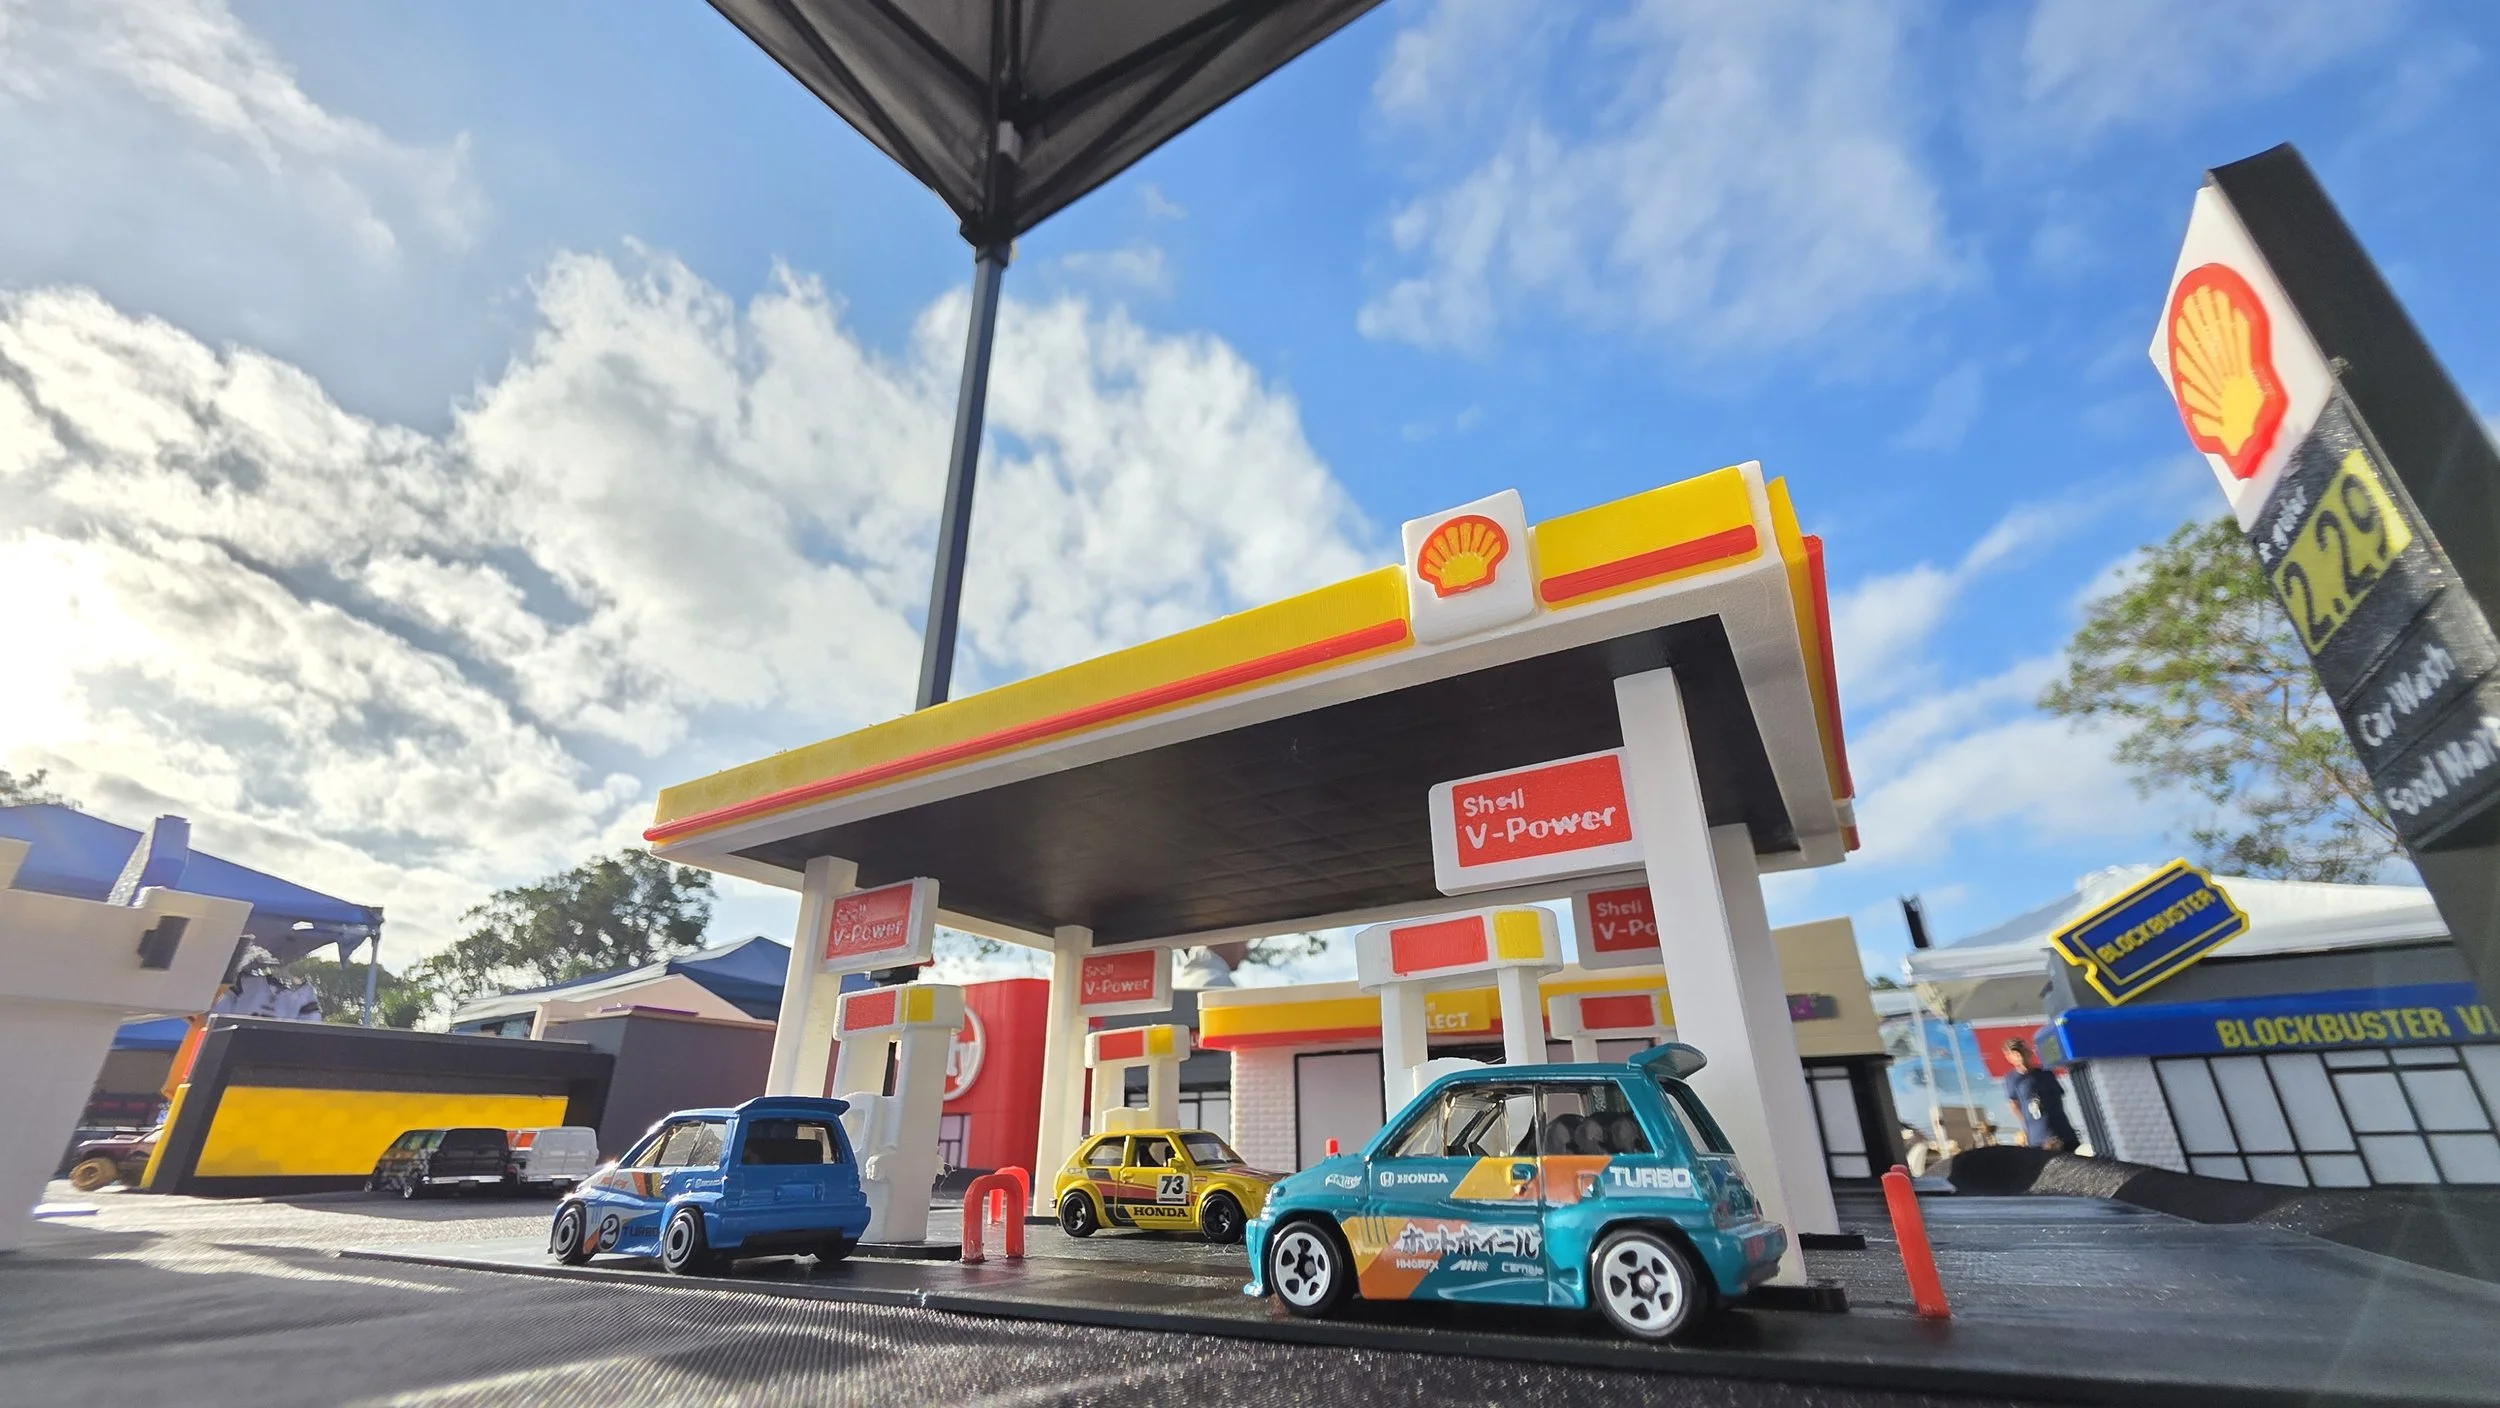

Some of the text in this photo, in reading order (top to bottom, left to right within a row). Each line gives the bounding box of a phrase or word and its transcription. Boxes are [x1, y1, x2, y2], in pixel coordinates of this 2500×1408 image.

[2283, 473, 2388, 645] 2.29
[2358, 643, 2455, 746] Car Wash
[1463, 788, 1525, 817] Shell
[1465, 807, 1617, 849] V-Power
[1596, 900, 1643, 917] Shell
[1599, 918, 1658, 940] V-Po
[2096, 888, 2217, 964] BLOCKBUSTER
[1085, 978, 1150, 996] V-Power
[1426, 1012, 1469, 1029] LECT
[2215, 1006, 2451, 1049] BLOCKBUSTER
[1161, 1175, 1185, 1195] 73
[1397, 1172, 1449, 1184] HONDA
[1609, 1166, 1691, 1188] TURBO
[1133, 1206, 1188, 1218] HONDA
[600, 1217, 618, 1244] 2
